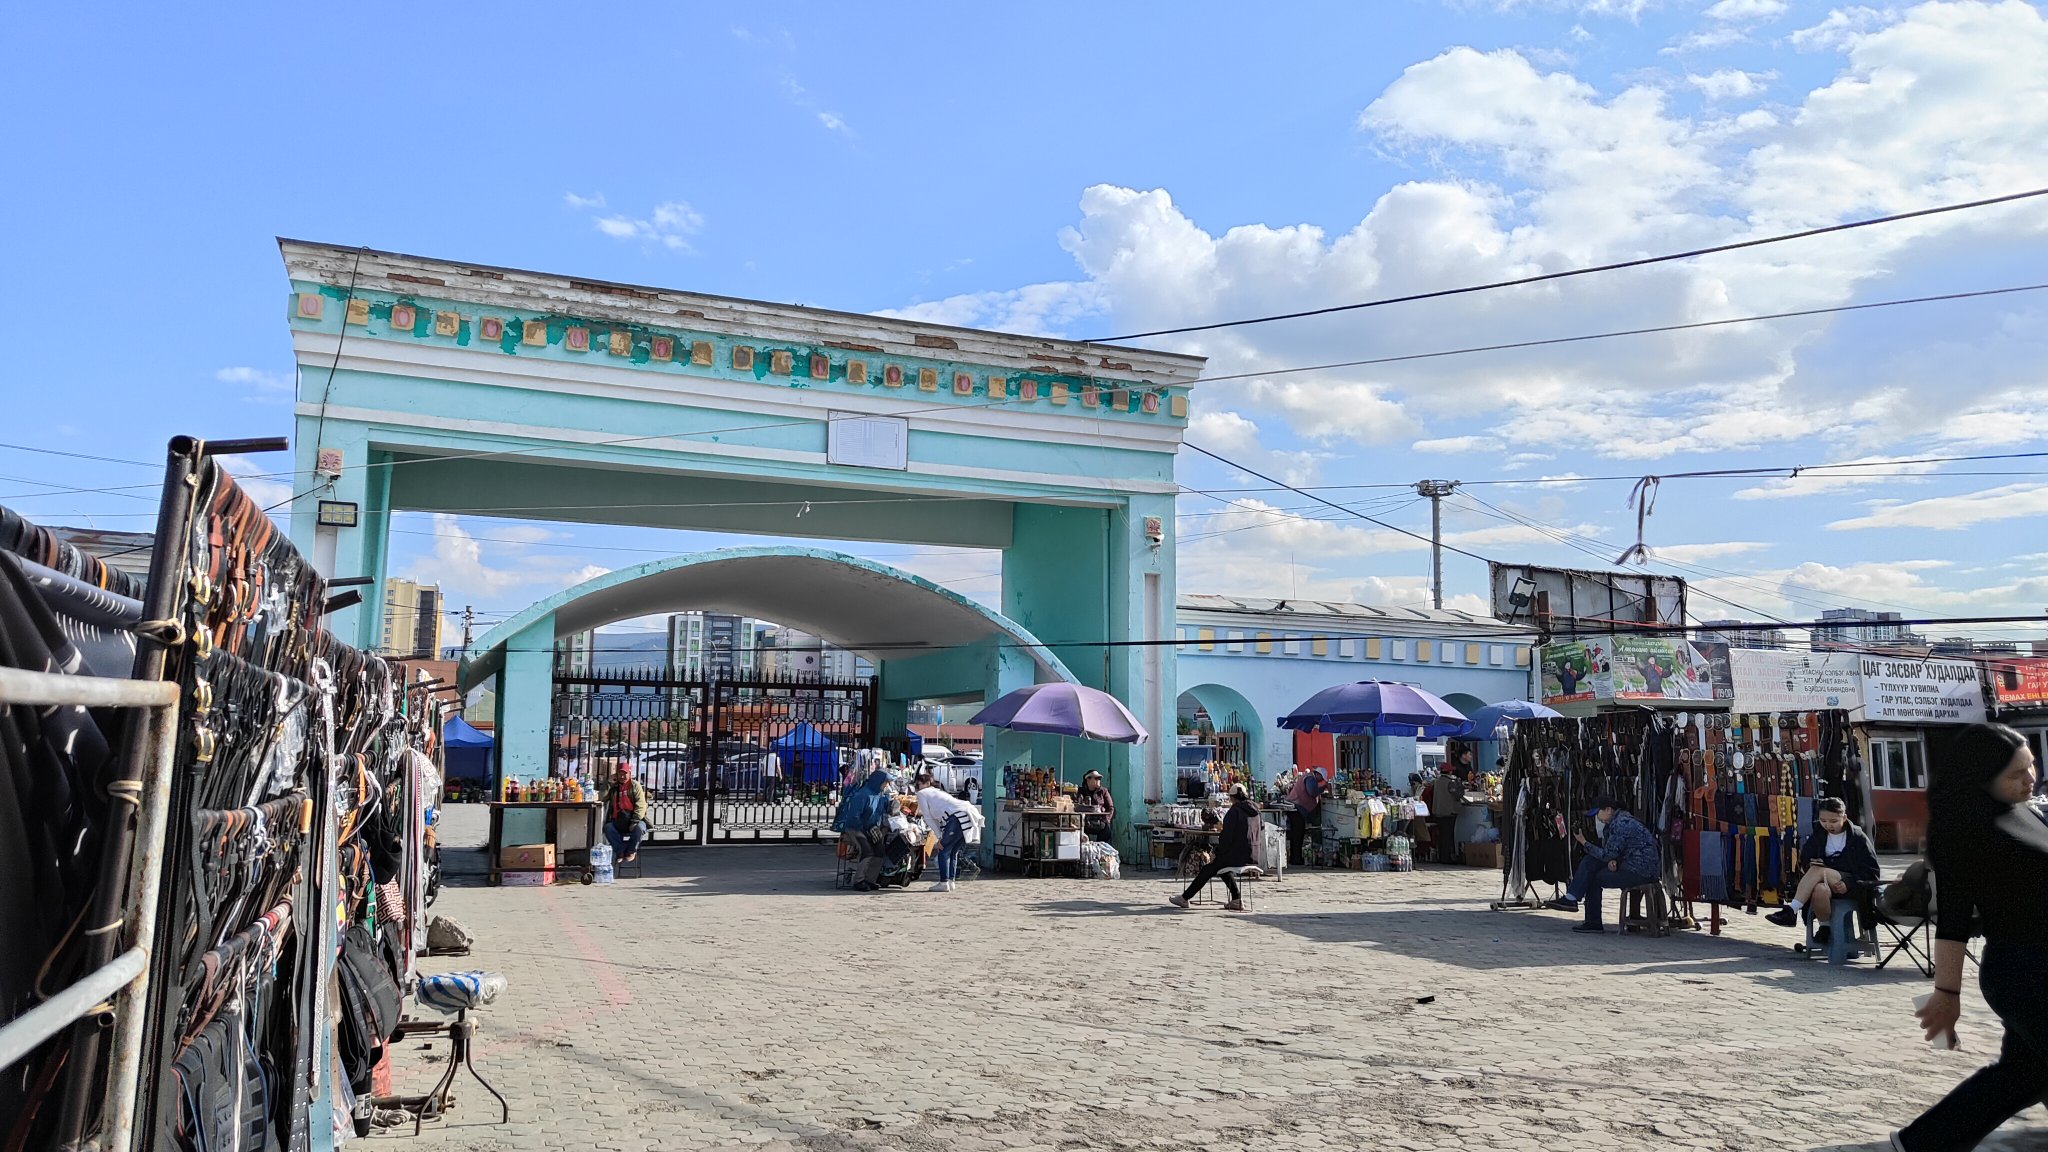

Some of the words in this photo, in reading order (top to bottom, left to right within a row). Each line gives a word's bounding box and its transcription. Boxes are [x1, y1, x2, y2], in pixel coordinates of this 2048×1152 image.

[1862, 660, 1881, 679] ЦАГ
[1885, 662, 1922, 679] ЗАСВАР
[1925, 663, 1977, 684] ХУДАЛДАА
[1880, 683, 1908, 693] ТҮЛХҮҮР
[1910, 684, 1939, 694] ХУВИЛНА
[1881, 695, 1894, 705] ГАР
[1895, 696, 1913, 707] УТАС,
[1914, 696, 1938, 706] СЭЛБЭГ
[1939, 697, 1973, 708] ХУДАЛДАА
[1999, 693, 2026, 701] REMAX
[1882, 708, 1896, 717] АЛТ
[1896, 708, 1933, 718] МӨНГӨНИЙ
[1934, 709, 1960, 719] ДАРХАН
